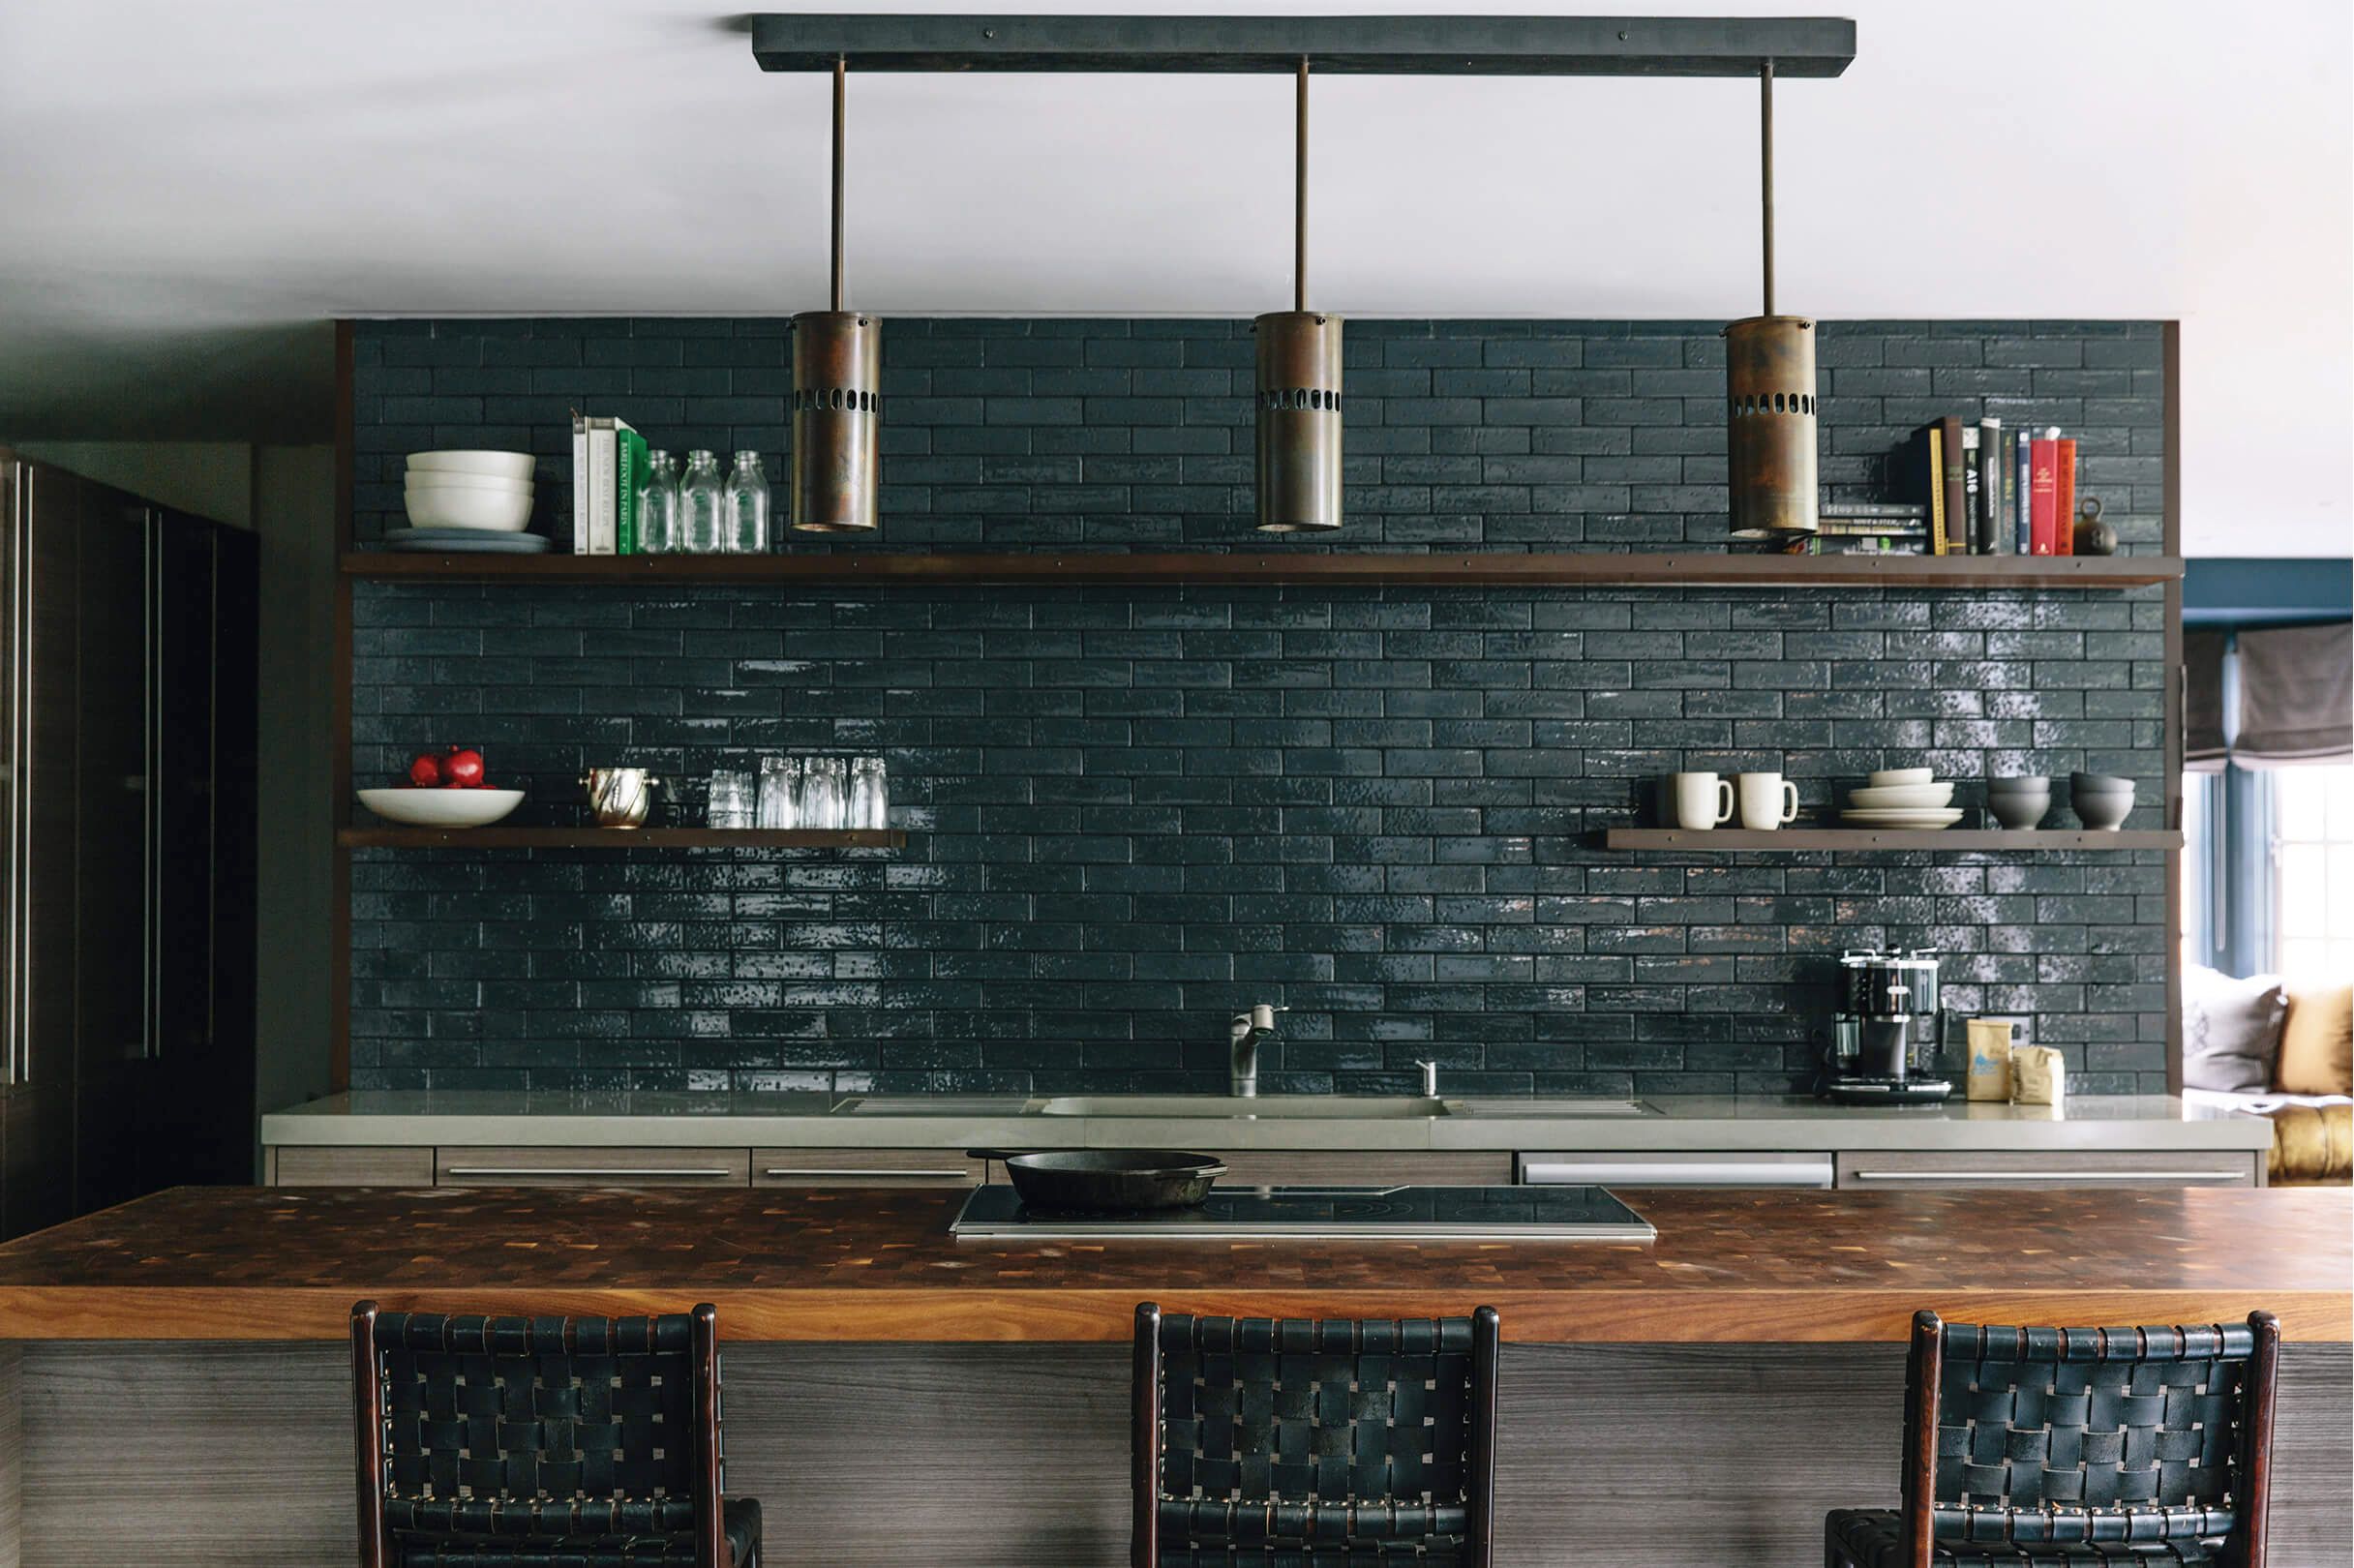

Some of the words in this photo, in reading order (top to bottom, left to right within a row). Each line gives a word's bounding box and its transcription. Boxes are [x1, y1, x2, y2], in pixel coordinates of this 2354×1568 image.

[620, 442, 629, 487] BAREFOOT
[1966, 468, 1978, 494] A16
[620, 489, 629, 499] IN
[620, 501, 629, 525] PARIS
